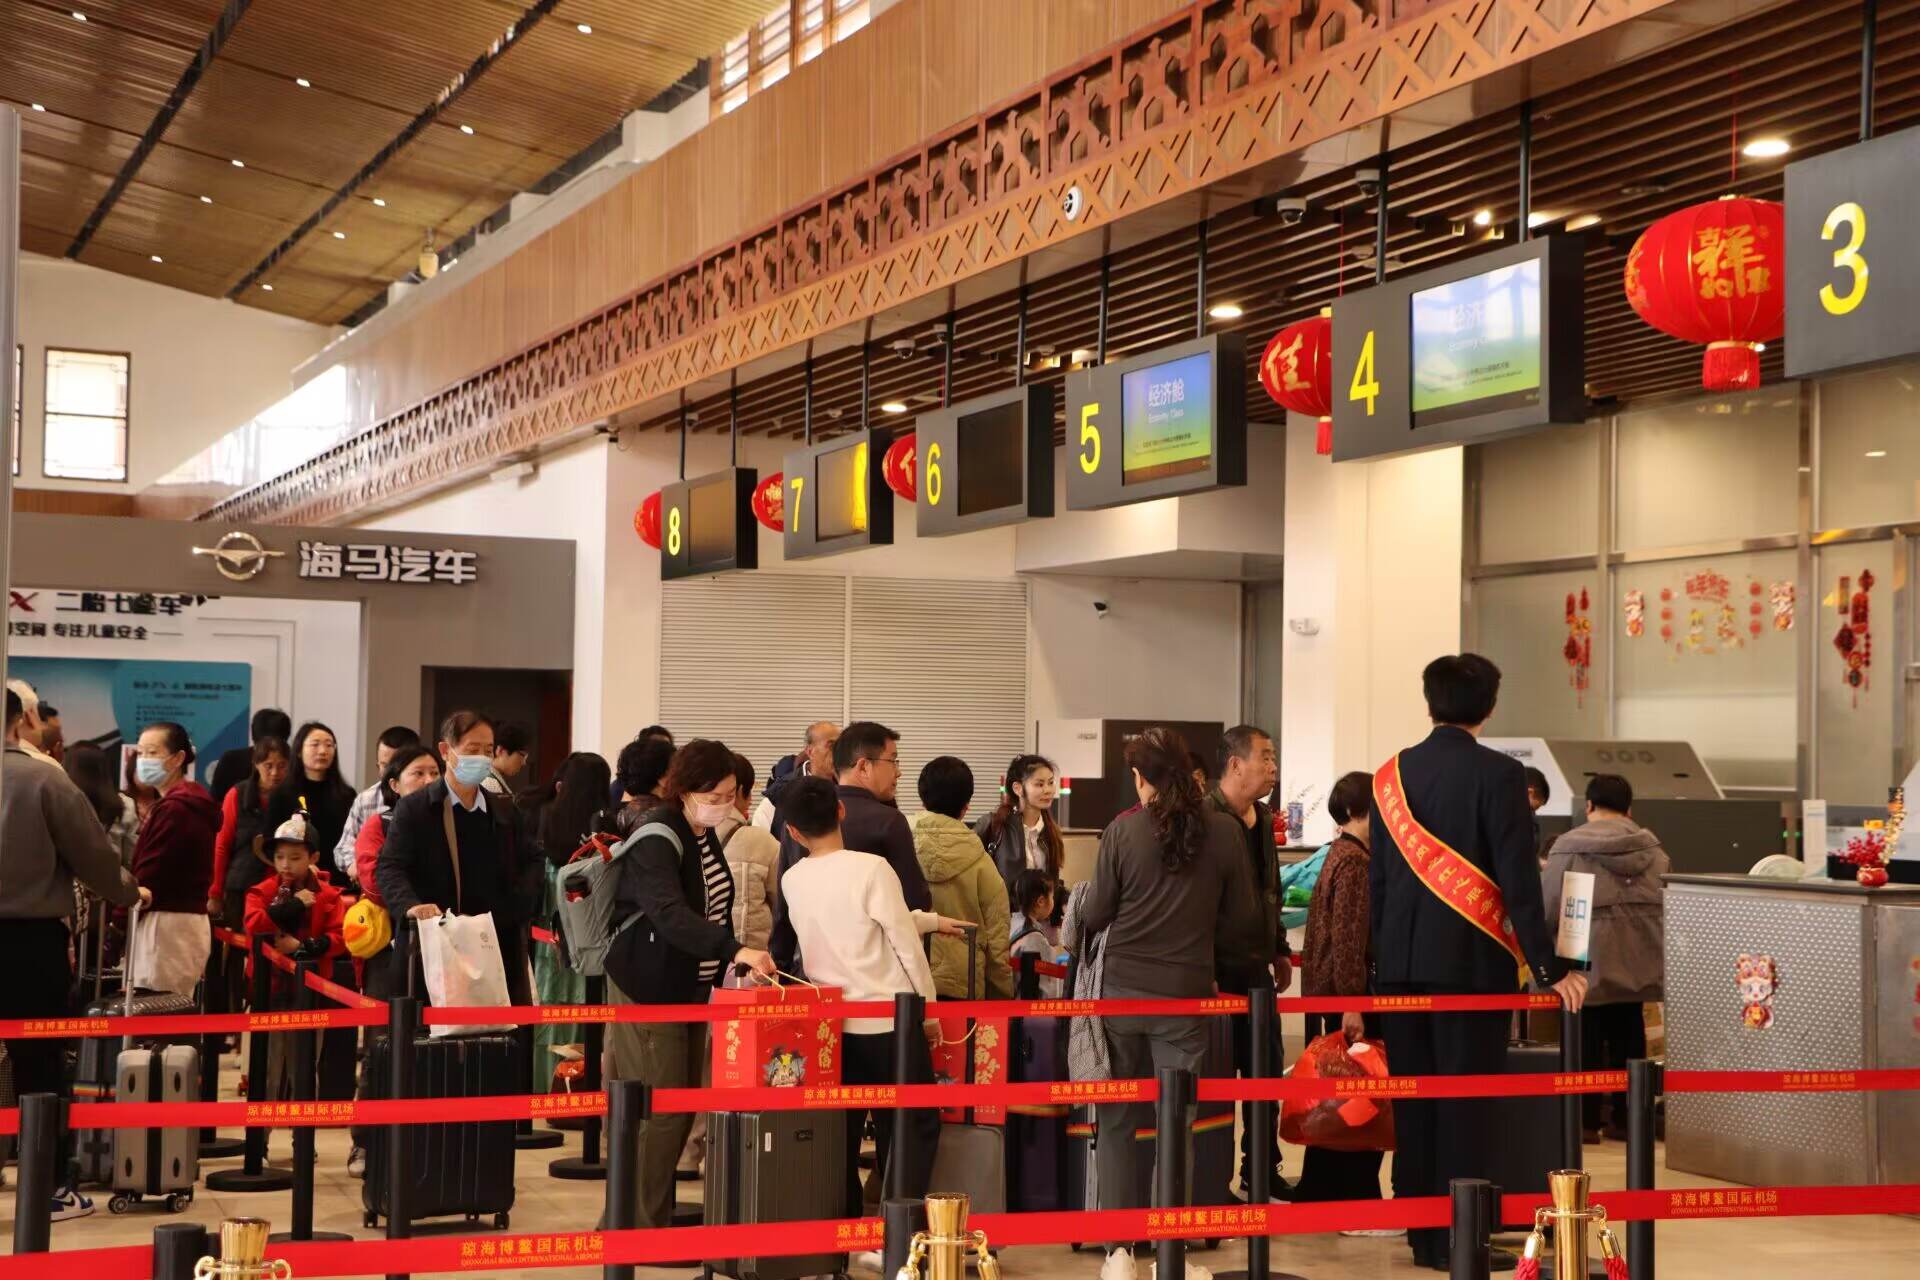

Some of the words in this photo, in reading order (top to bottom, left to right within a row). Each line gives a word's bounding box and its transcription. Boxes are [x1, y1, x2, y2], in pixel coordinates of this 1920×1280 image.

[1819, 202, 1869, 316] 3
[1350, 331, 1380, 416] 4
[1079, 403, 1101, 475] 5
[926, 442, 942, 506] 6
[791, 477, 804, 533] 7
[668, 507, 681, 556] 8
[300, 541, 477, 584] 海马汽车
[9, 621, 47, 638] 空间
[53, 623, 148, 640] 专注儿童安全
[248, 1103, 354, 1117] 琼海博鳌国际机场
[1148, 1208, 1266, 1227] 琼海博鳌国际机场
[1671, 1190, 1777, 1206] 琼海博鳌国际机场
[462, 1235, 604, 1257] 琼海博鳌国际机场
[575, 1252, 604, 1261] AIRPORT
